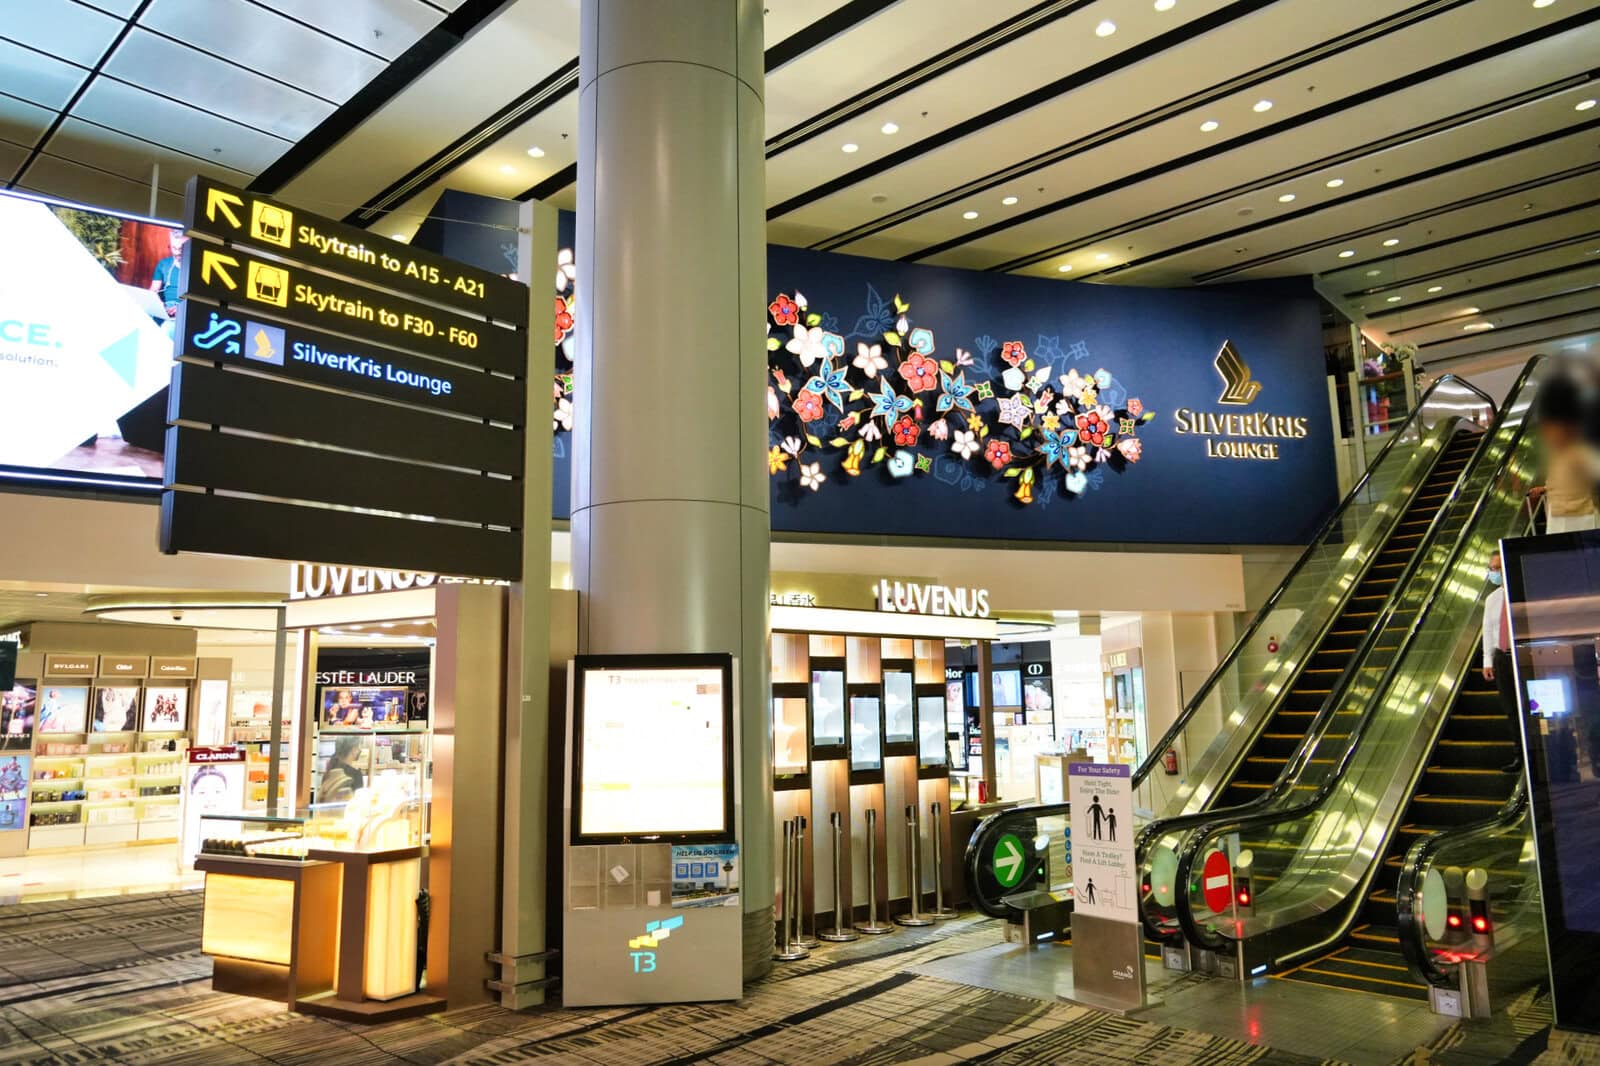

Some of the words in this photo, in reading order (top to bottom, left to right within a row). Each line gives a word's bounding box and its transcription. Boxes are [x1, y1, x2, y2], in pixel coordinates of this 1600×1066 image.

[298, 225, 376, 265] Skytrain
[380, 250, 401, 272] to
[404, 261, 440, 285] A15
[453, 275, 486, 299] A21
[295, 284, 374, 322] Skytrain
[378, 307, 399, 328] to
[403, 314, 435, 338] F30
[449, 327, 478, 350] F60
[293, 342, 382, 378] SilverKris
[386, 364, 452, 396] Lounge
[1207, 438, 1280, 460] LOUNGE
[879, 578, 990, 618] LUVENUS
[359, 671, 416, 684] LAUDER
[629, 951, 657, 974] T3
